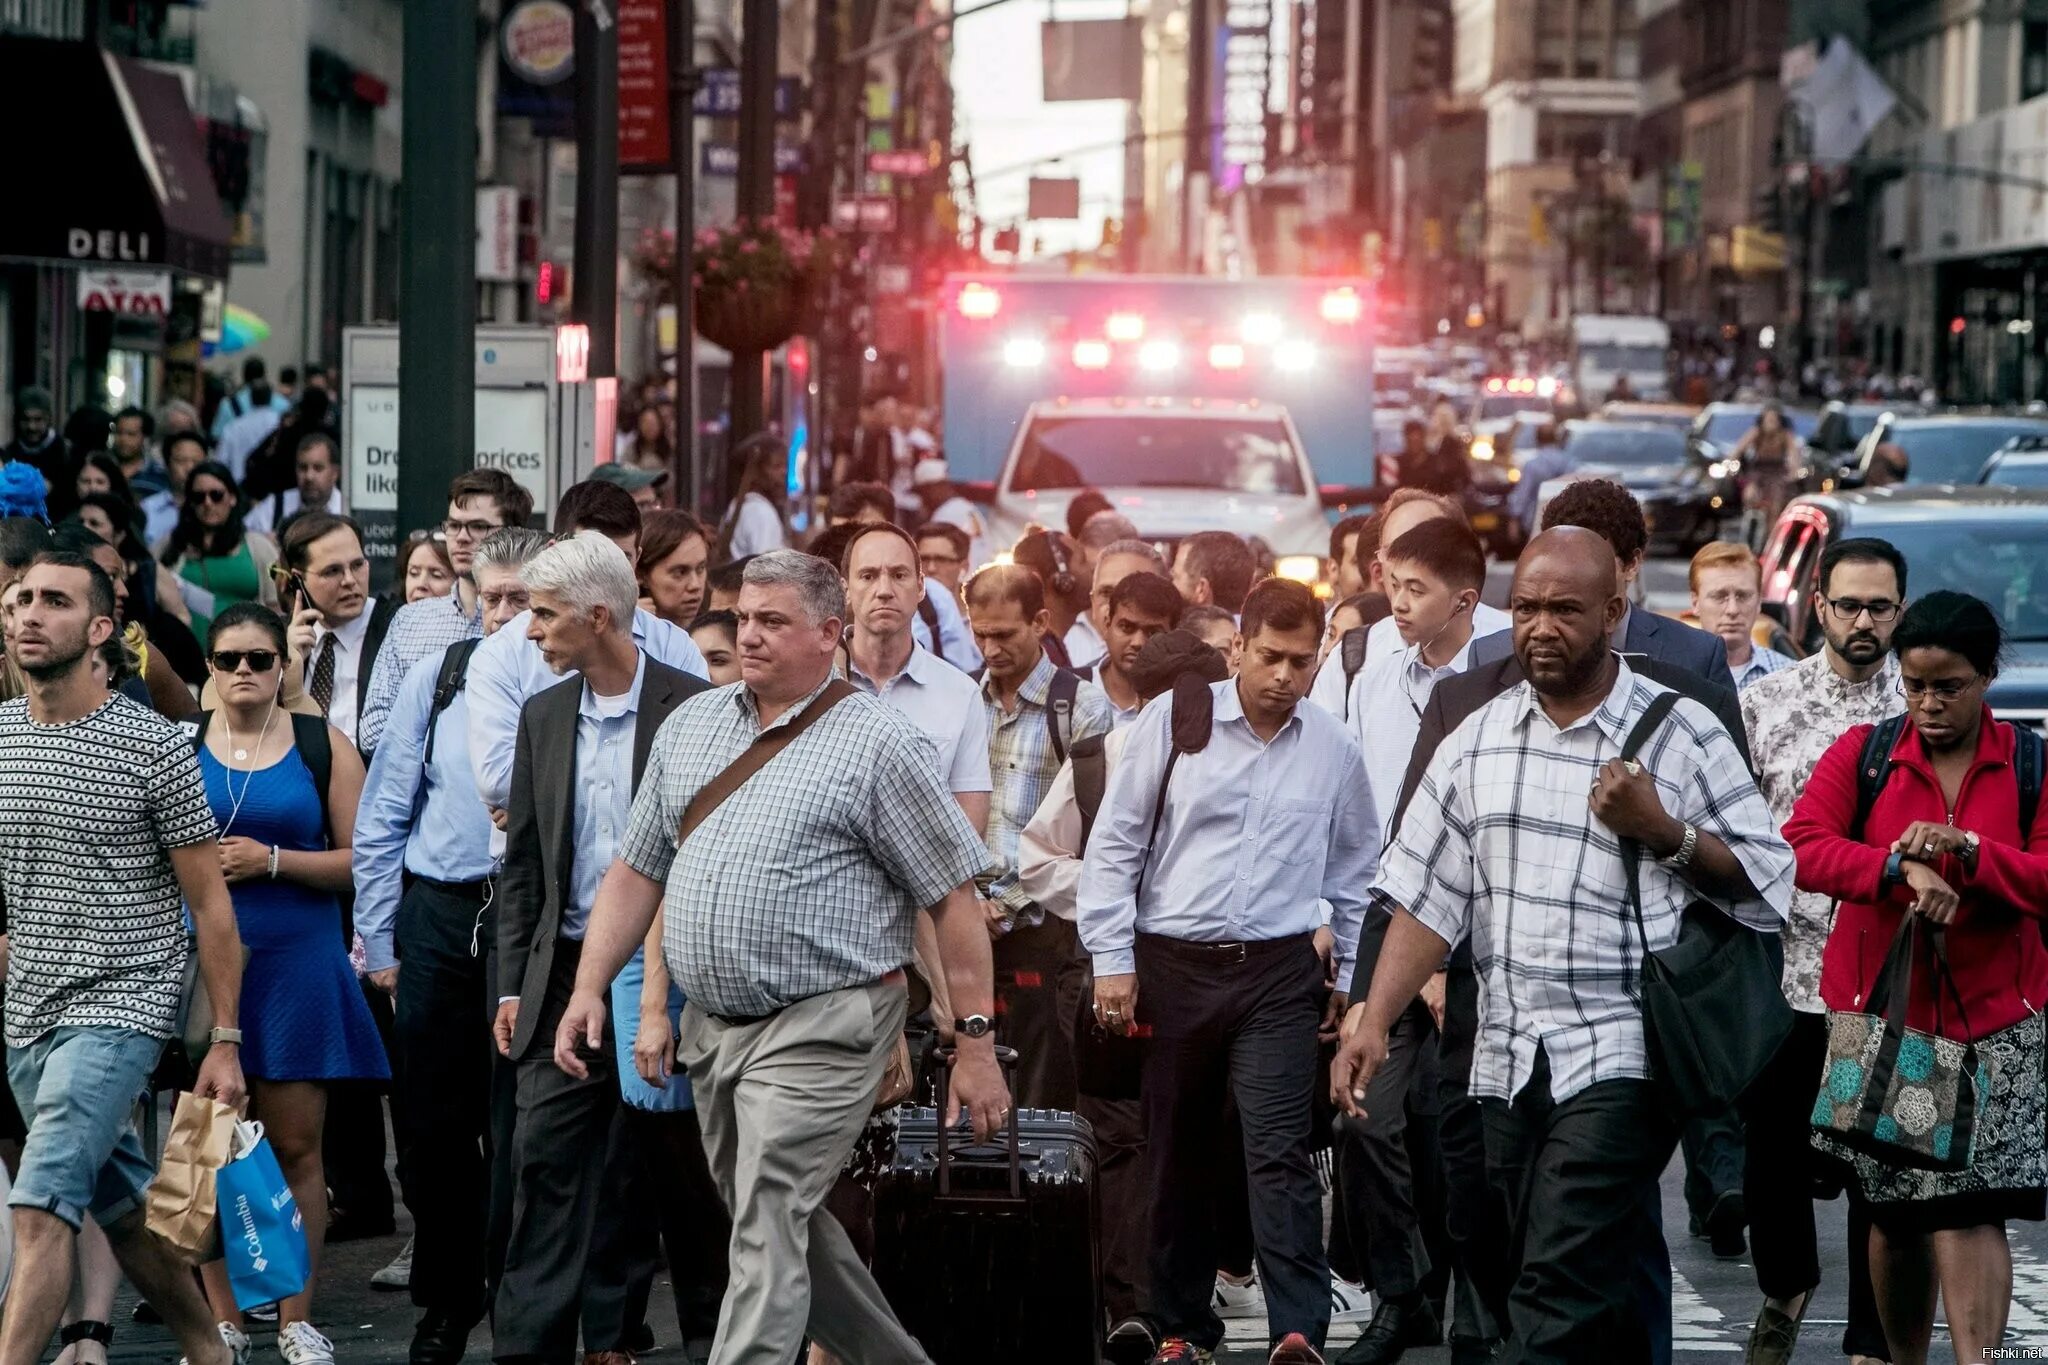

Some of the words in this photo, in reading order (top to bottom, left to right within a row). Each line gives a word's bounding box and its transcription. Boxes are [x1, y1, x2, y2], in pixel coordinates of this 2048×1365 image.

[68, 228, 149, 261] DELI
[85, 290, 168, 318] ATM
[366, 446, 398, 466] Dr
[476, 447, 541, 470] prices
[364, 542, 397, 557] chea
[235, 1194, 263, 1258] Columbia
